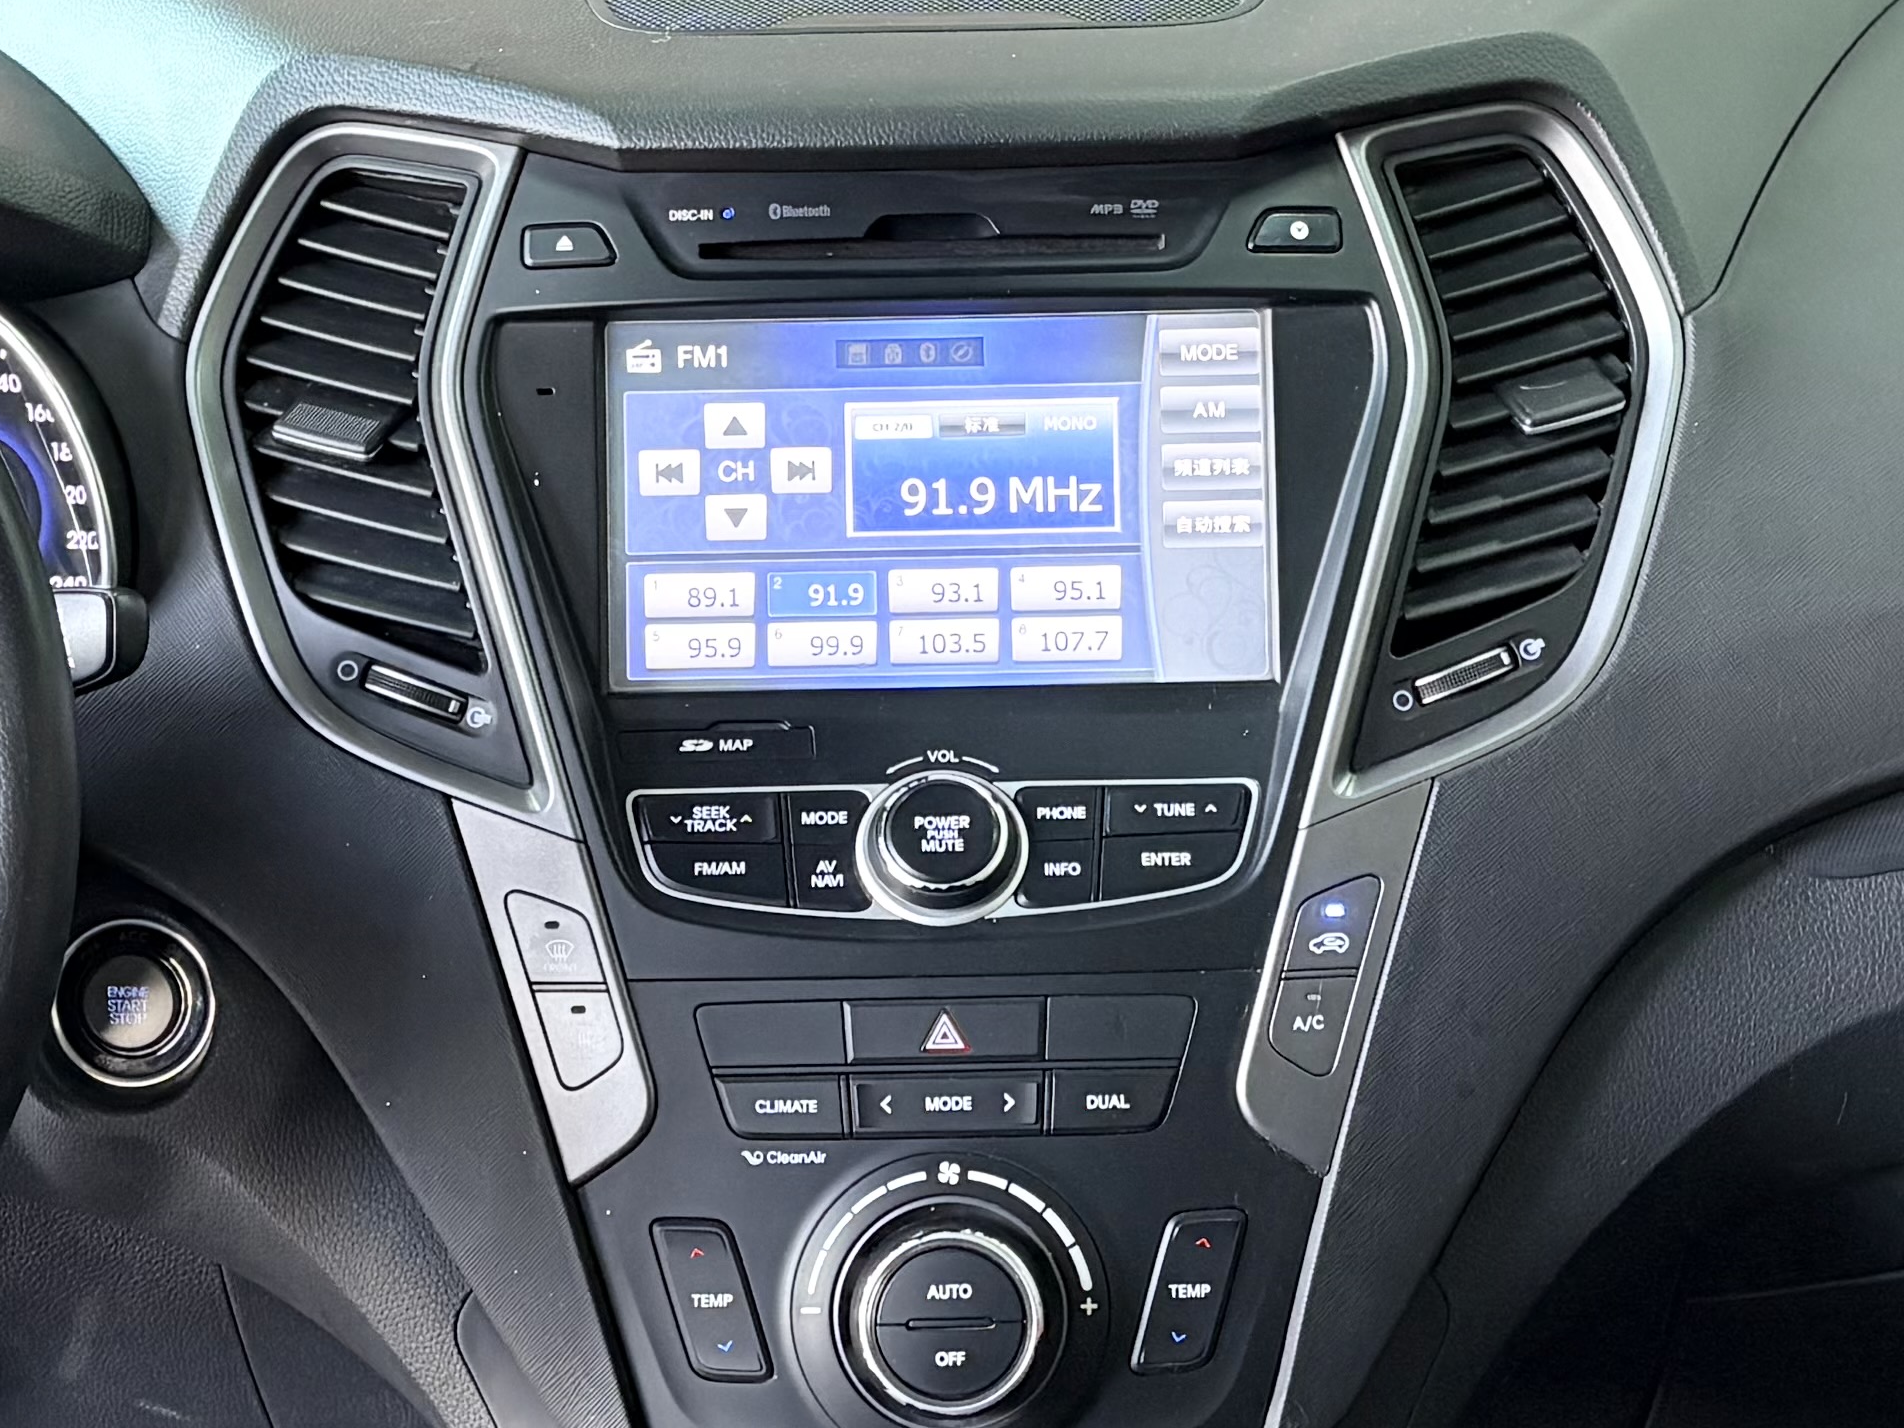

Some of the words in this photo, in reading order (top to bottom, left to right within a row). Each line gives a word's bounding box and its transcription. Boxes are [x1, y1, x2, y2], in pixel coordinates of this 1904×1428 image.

[668, 209, 713, 222] DISC-IN
[781, 204, 831, 218] Bluetooth
[677, 345, 728, 368] FM1
[1180, 344, 1239, 361] MODE
[1192, 402, 1226, 419] AM
[963, 415, 1000, 434] 标准
[1044, 416, 1097, 432] MONO
[717, 460, 755, 483] CH
[1173, 458, 1251, 477] 频道列表
[900, 476, 996, 517] 91.9
[1008, 475, 1104, 514] MHz
[1176, 515, 1252, 535] 自动搜索
[687, 586, 741, 608] 89.1
[773, 577, 783, 591] 2
[807, 582, 865, 608] 91.9
[931, 581, 985, 603] 93.1
[1053, 579, 1107, 603] 95.1
[687, 637, 742, 659] 95.9
[810, 635, 865, 657] 99.9
[918, 633, 988, 655] 103.5
[1040, 629, 1110, 653] 107.7
[718, 738, 754, 752] MAP
[926, 749, 960, 764] VOL
[692, 805, 731, 819] SEEK
[801, 810, 848, 826] MODE
[1035, 806, 1087, 821] PHONE
[1153, 803, 1196, 818] TUNE
[684, 818, 738, 833] TRACK
[913, 815, 971, 830] POWER
[926, 829, 959, 840] PUSH
[921, 839, 965, 853] MUTE
[815, 860, 838, 874] AV
[1140, 852, 1192, 868] ENTER
[694, 861, 746, 876] FM/AM
[1043, 862, 1082, 877] INFO
[810, 874, 844, 889] NAVI
[107, 985, 150, 998] ENGINE
[107, 999, 148, 1012] START
[109, 1013, 147, 1025] STOP
[1292, 1014, 1325, 1032] A/C
[754, 1098, 818, 1115] CLIMATE
[924, 1096, 973, 1112] MODE
[1085, 1094, 1131, 1110] DUAL
[765, 1150, 827, 1165] CleanAir
[926, 1283, 973, 1300] AUTO
[1167, 1283, 1212, 1300] TEMP
[691, 1293, 734, 1309] TEMP
[934, 1351, 967, 1368] OFF
